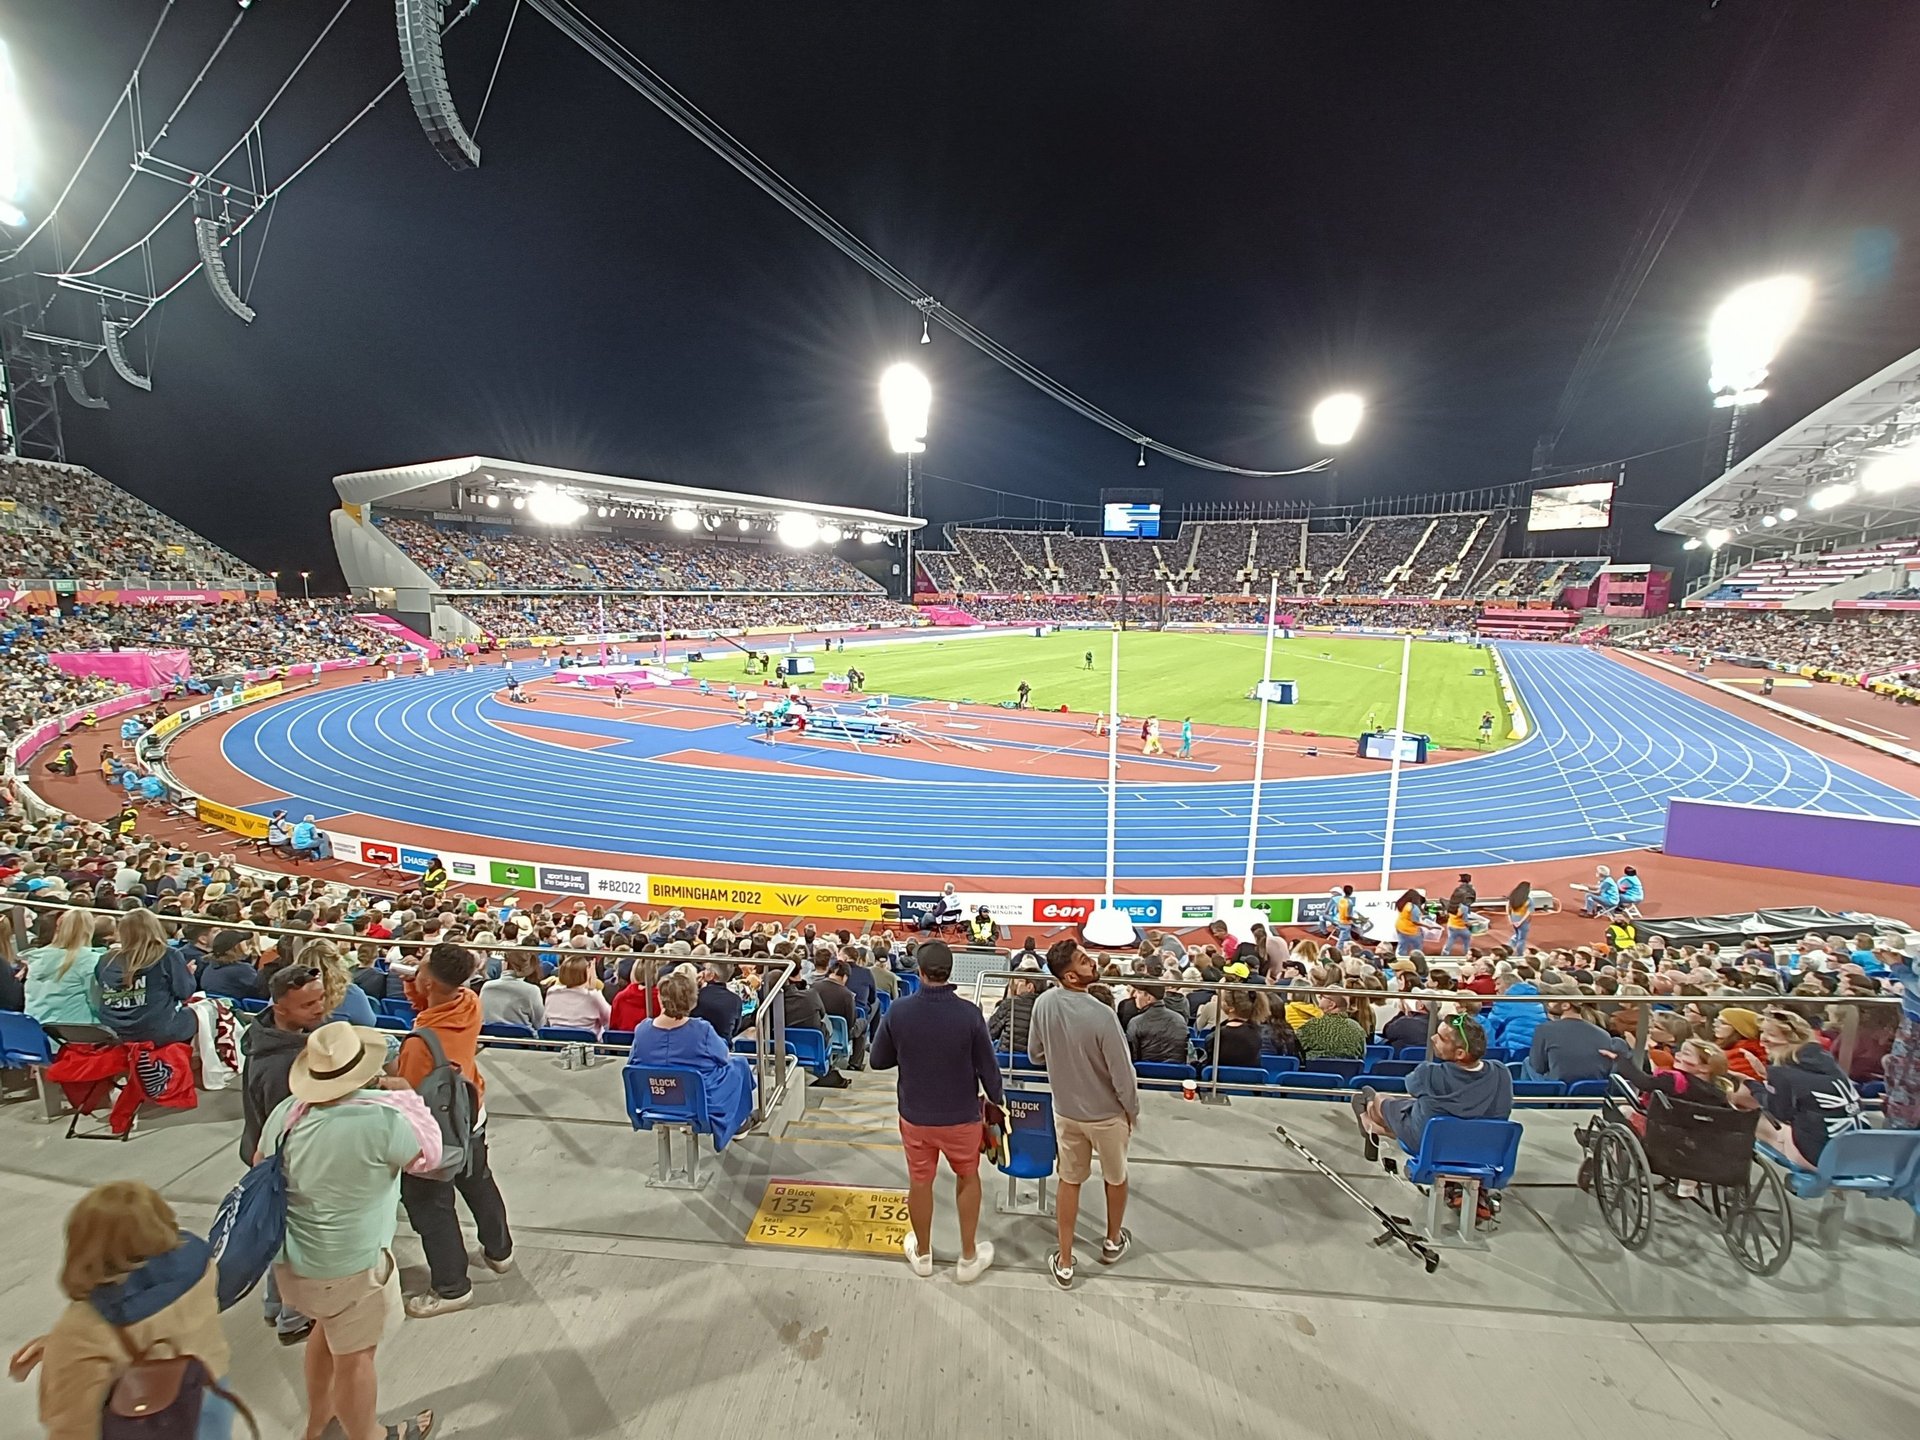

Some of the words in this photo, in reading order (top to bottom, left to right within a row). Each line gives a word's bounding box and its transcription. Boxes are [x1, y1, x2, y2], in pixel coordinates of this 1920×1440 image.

[403, 855, 428, 866] CHASE
[598, 879, 641, 894] #B2022
[653, 884, 728, 901] BIRMINGHAM
[731, 890, 761, 904] 2022
[816, 894, 890, 906] commonwealth
[836, 903, 870, 913] games
[649, 1077, 677, 1087] BLOCK
[650, 1086, 666, 1096] 135
[1011, 1100, 1040, 1111] BLOCK
[1011, 1109, 1026, 1119] 136
[786, 1188, 816, 1198] Block
[870, 1194, 900, 1204] Block
[771, 1197, 814, 1215] 135
[867, 1204, 910, 1222] 136
[763, 1216, 784, 1224] Seats
